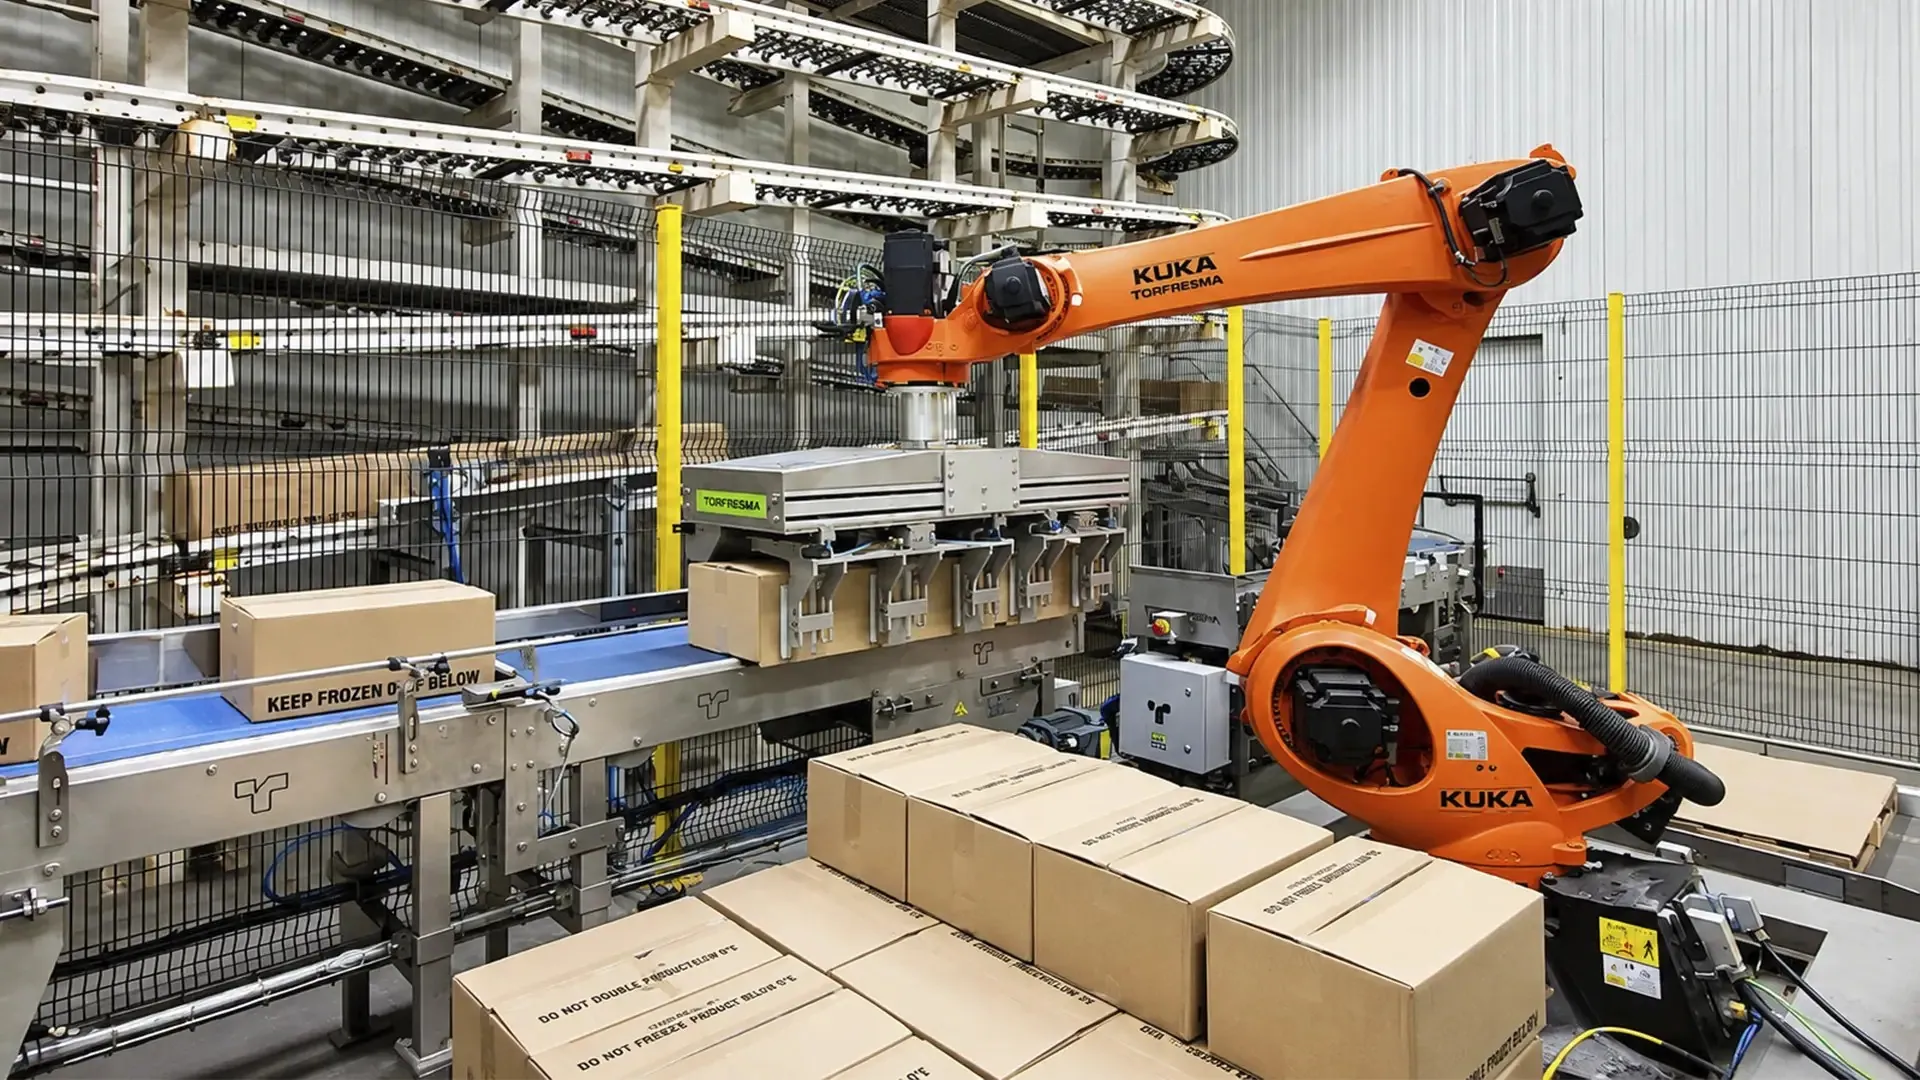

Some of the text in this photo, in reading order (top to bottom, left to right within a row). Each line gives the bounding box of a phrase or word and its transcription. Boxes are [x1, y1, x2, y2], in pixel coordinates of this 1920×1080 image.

[1133, 256, 1217, 286] KUKA
[1130, 275, 1224, 300] TORFRESMA
[703, 496, 761, 511] TORFRESMA
[267, 692, 313, 713] KEEP
[318, 683, 383, 706] FROZEN
[428, 670, 480, 690] BELOW
[1441, 790, 1534, 809] KUKA
[538, 1011, 560, 1024] DO
[561, 999, 591, 1015] NOT
[590, 980, 642, 1005] DOUBLE
[576, 1057, 601, 1072] DO
[602, 1043, 633, 1061] NOT
